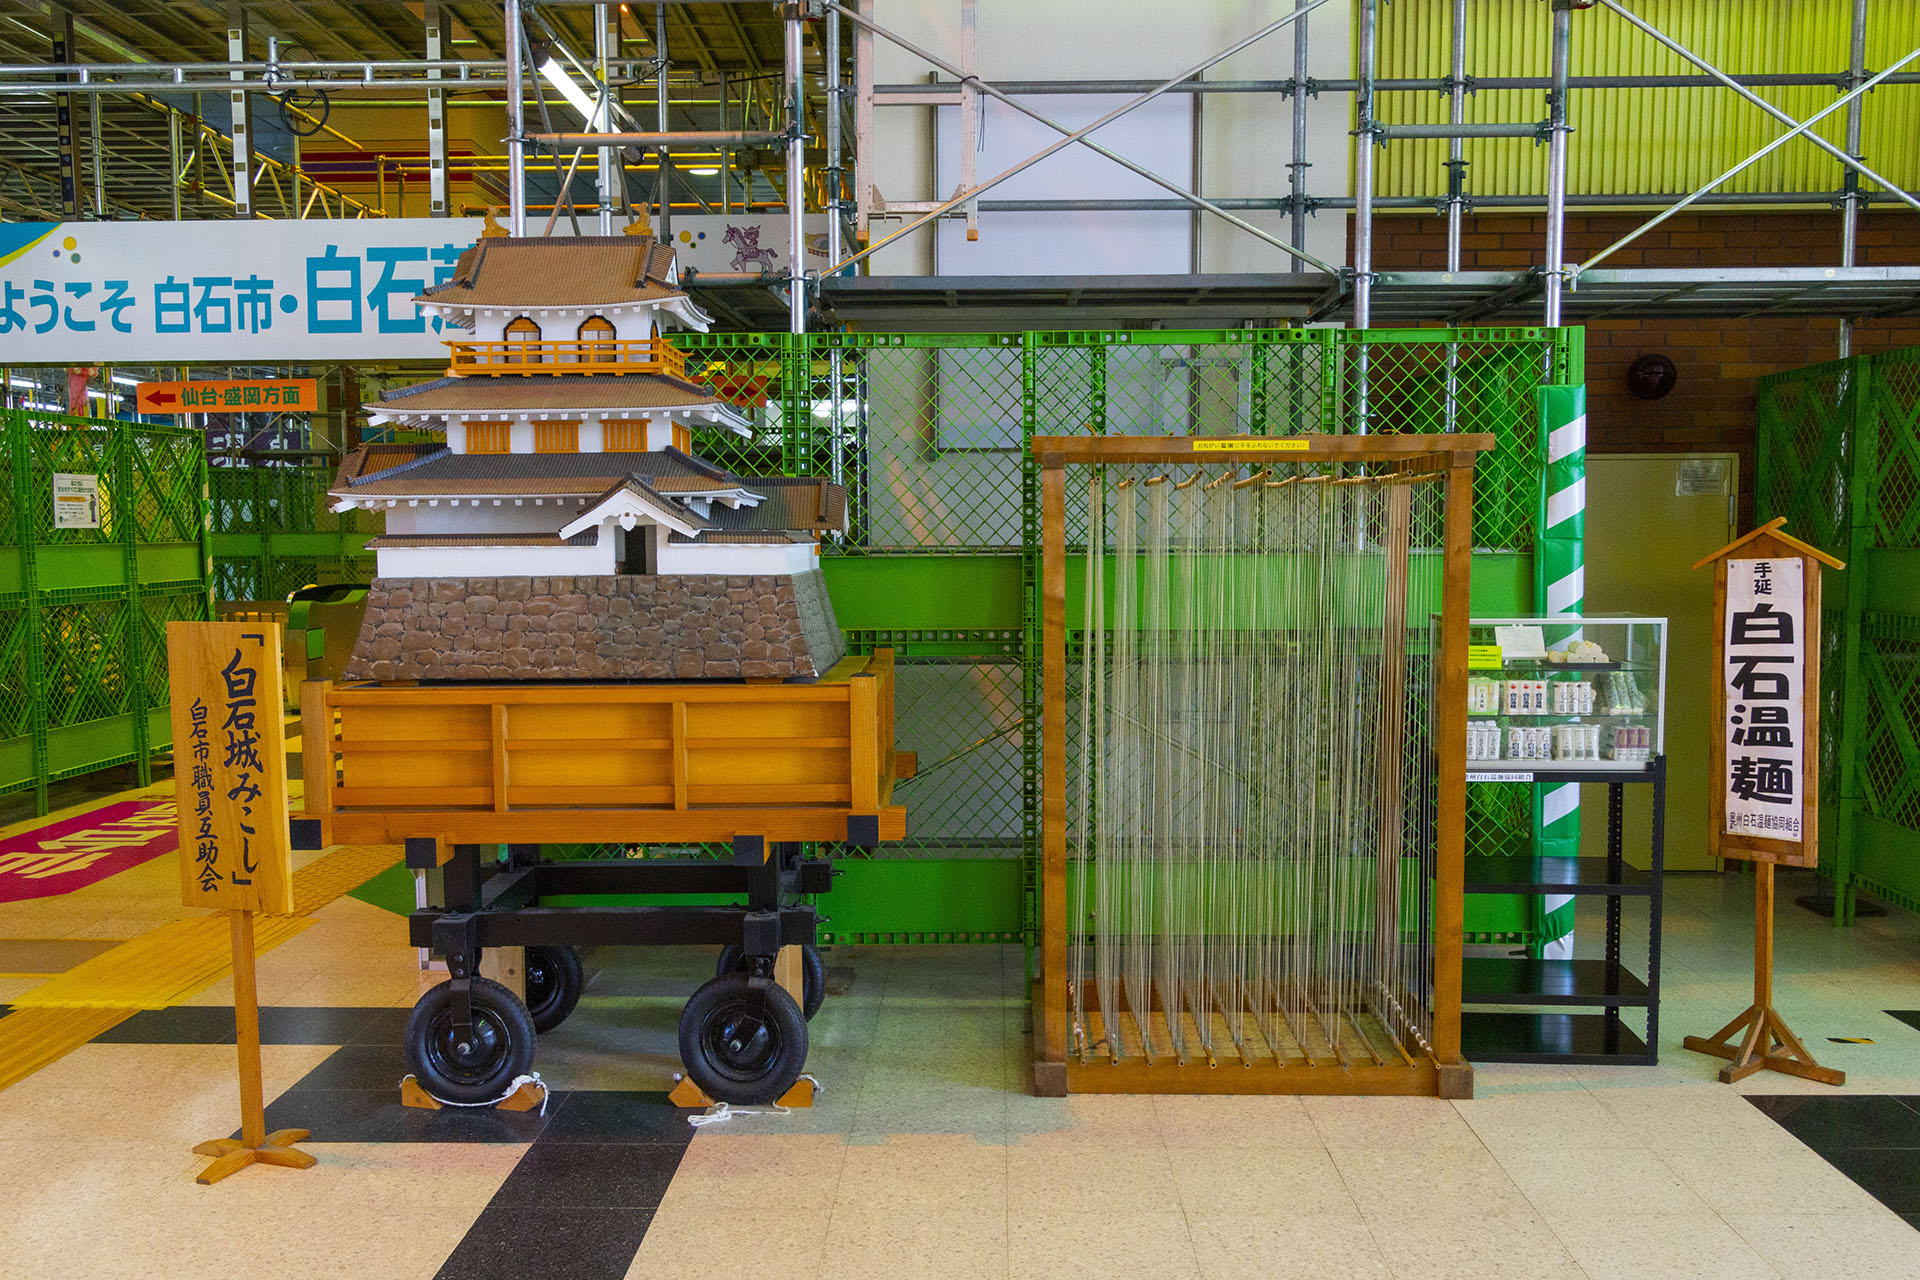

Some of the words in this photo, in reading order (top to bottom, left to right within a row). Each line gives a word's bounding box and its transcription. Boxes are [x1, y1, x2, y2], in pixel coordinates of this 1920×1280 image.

[181, 385, 300, 407] 仙台・盛岡方面
[1753, 562, 1773, 596] 手延
[188, 697, 224, 892] 白石市職員互助会
[220, 633, 264, 886] 「白石城みこし」
[1729, 603, 1795, 805] 白石温麺
